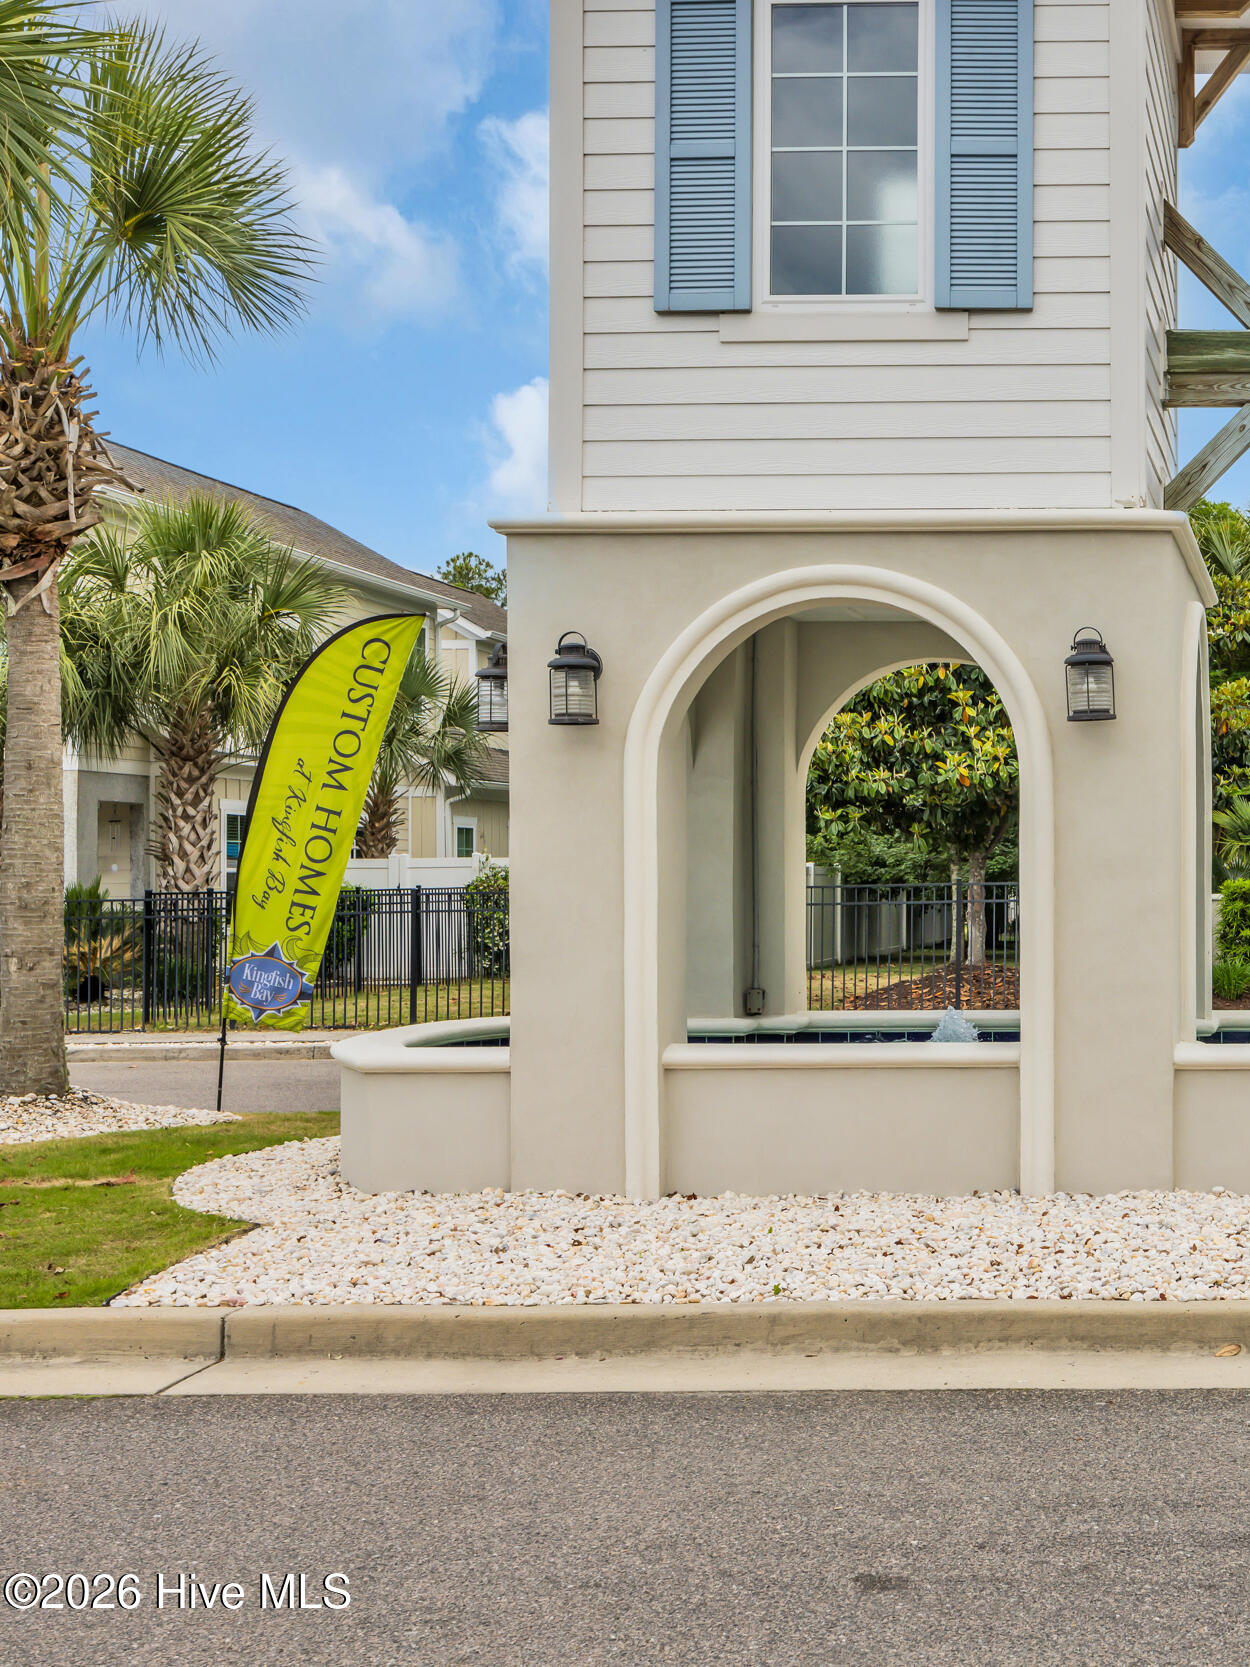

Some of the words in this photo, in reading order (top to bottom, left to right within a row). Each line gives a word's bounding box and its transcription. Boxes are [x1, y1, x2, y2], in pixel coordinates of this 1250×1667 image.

[320, 637, 391, 791] CUSTOM
[293, 757, 312, 791] at
[271, 785, 307, 868] Kingfish
[251, 868, 286, 910] Bay
[285, 804, 343, 936] HOMES
[243, 963, 294, 990] Kingfish
[250, 982, 274, 1005] Bay
